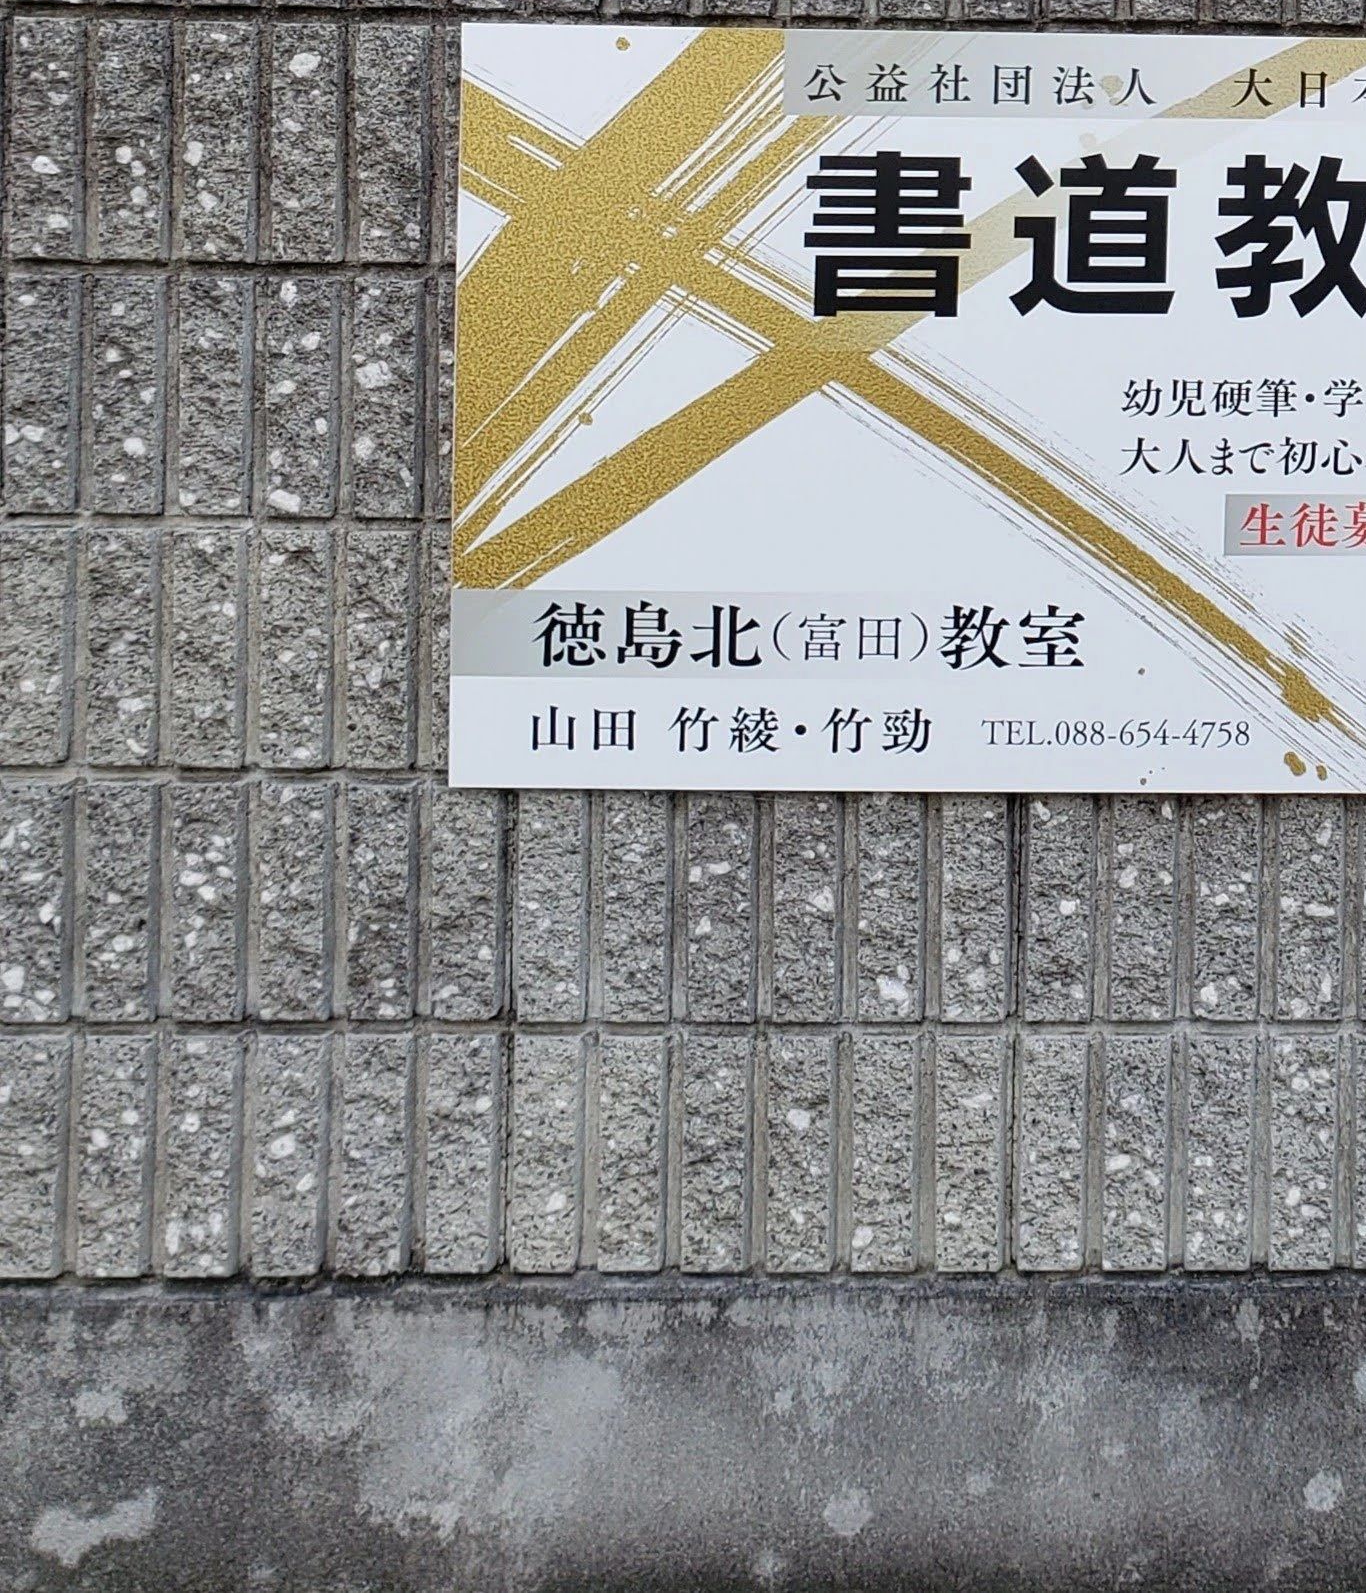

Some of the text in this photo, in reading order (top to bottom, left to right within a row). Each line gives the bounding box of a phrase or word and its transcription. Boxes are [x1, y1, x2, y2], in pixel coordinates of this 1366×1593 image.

[804, 63, 1157, 108] 公益社団法人
[530, 705, 1251, 756] 山田 竹綾・竹勁 TEL.088-654-4758
